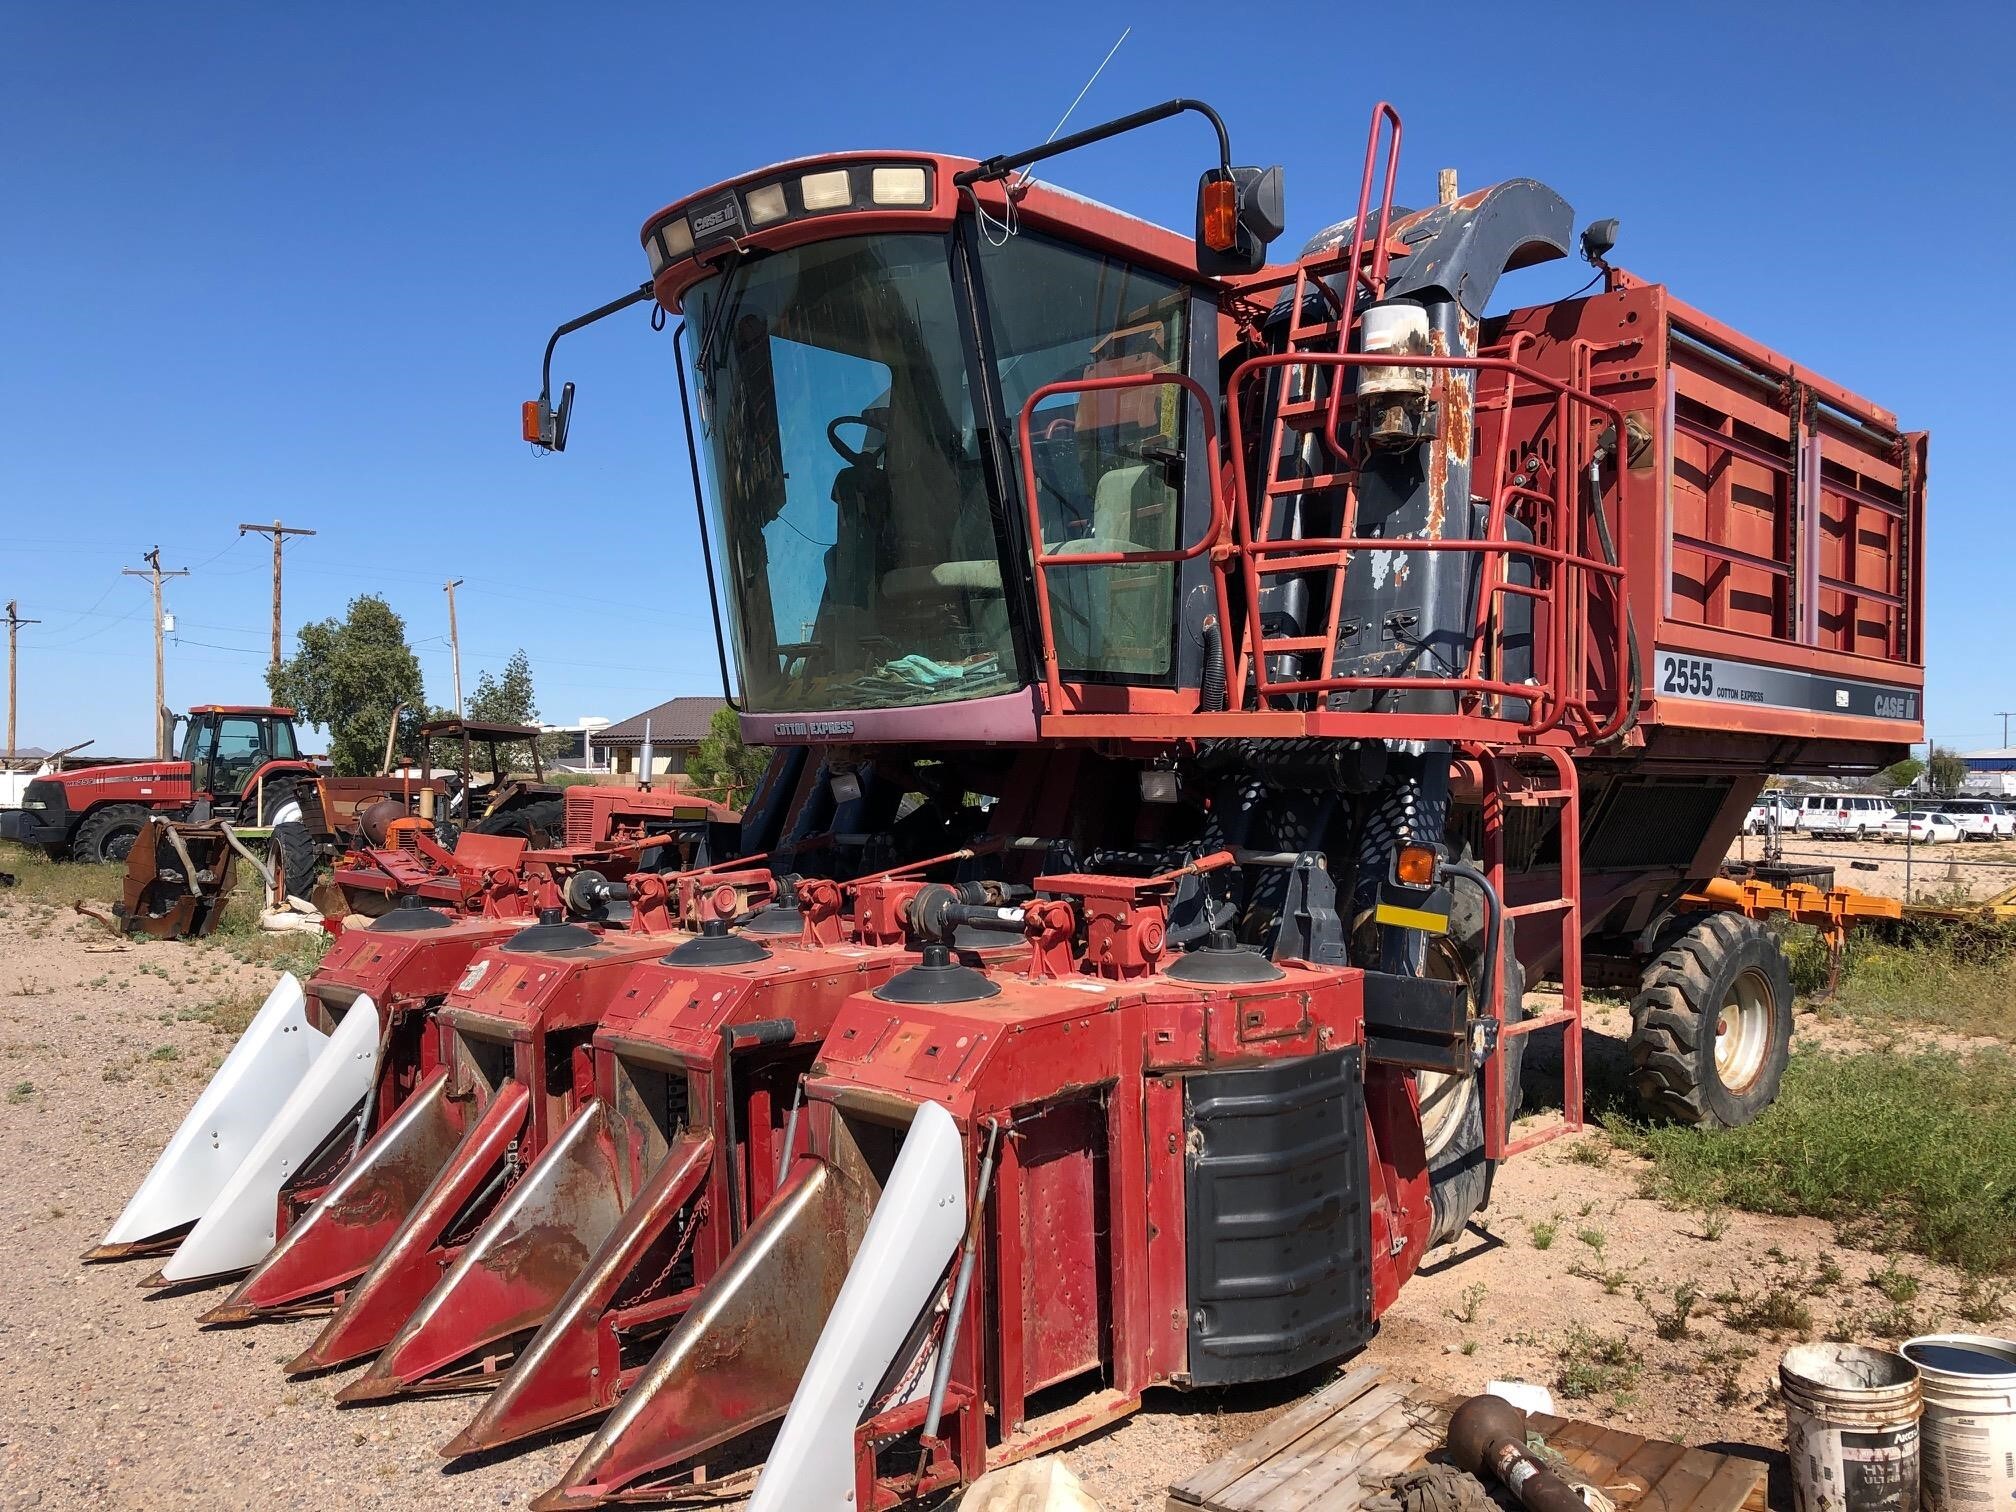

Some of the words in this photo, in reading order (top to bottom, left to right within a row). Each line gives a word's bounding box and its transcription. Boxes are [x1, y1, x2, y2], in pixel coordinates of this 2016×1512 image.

[694, 210, 724, 231] CASE
[1663, 657, 1713, 696] 2555
[1716, 687, 1739, 700] COTTON
[1740, 689, 1764, 702] EXPRESS
[1874, 694, 1904, 717] CASE
[774, 722, 807, 736] COTTON
[809, 720, 855, 735] EXPRESS
